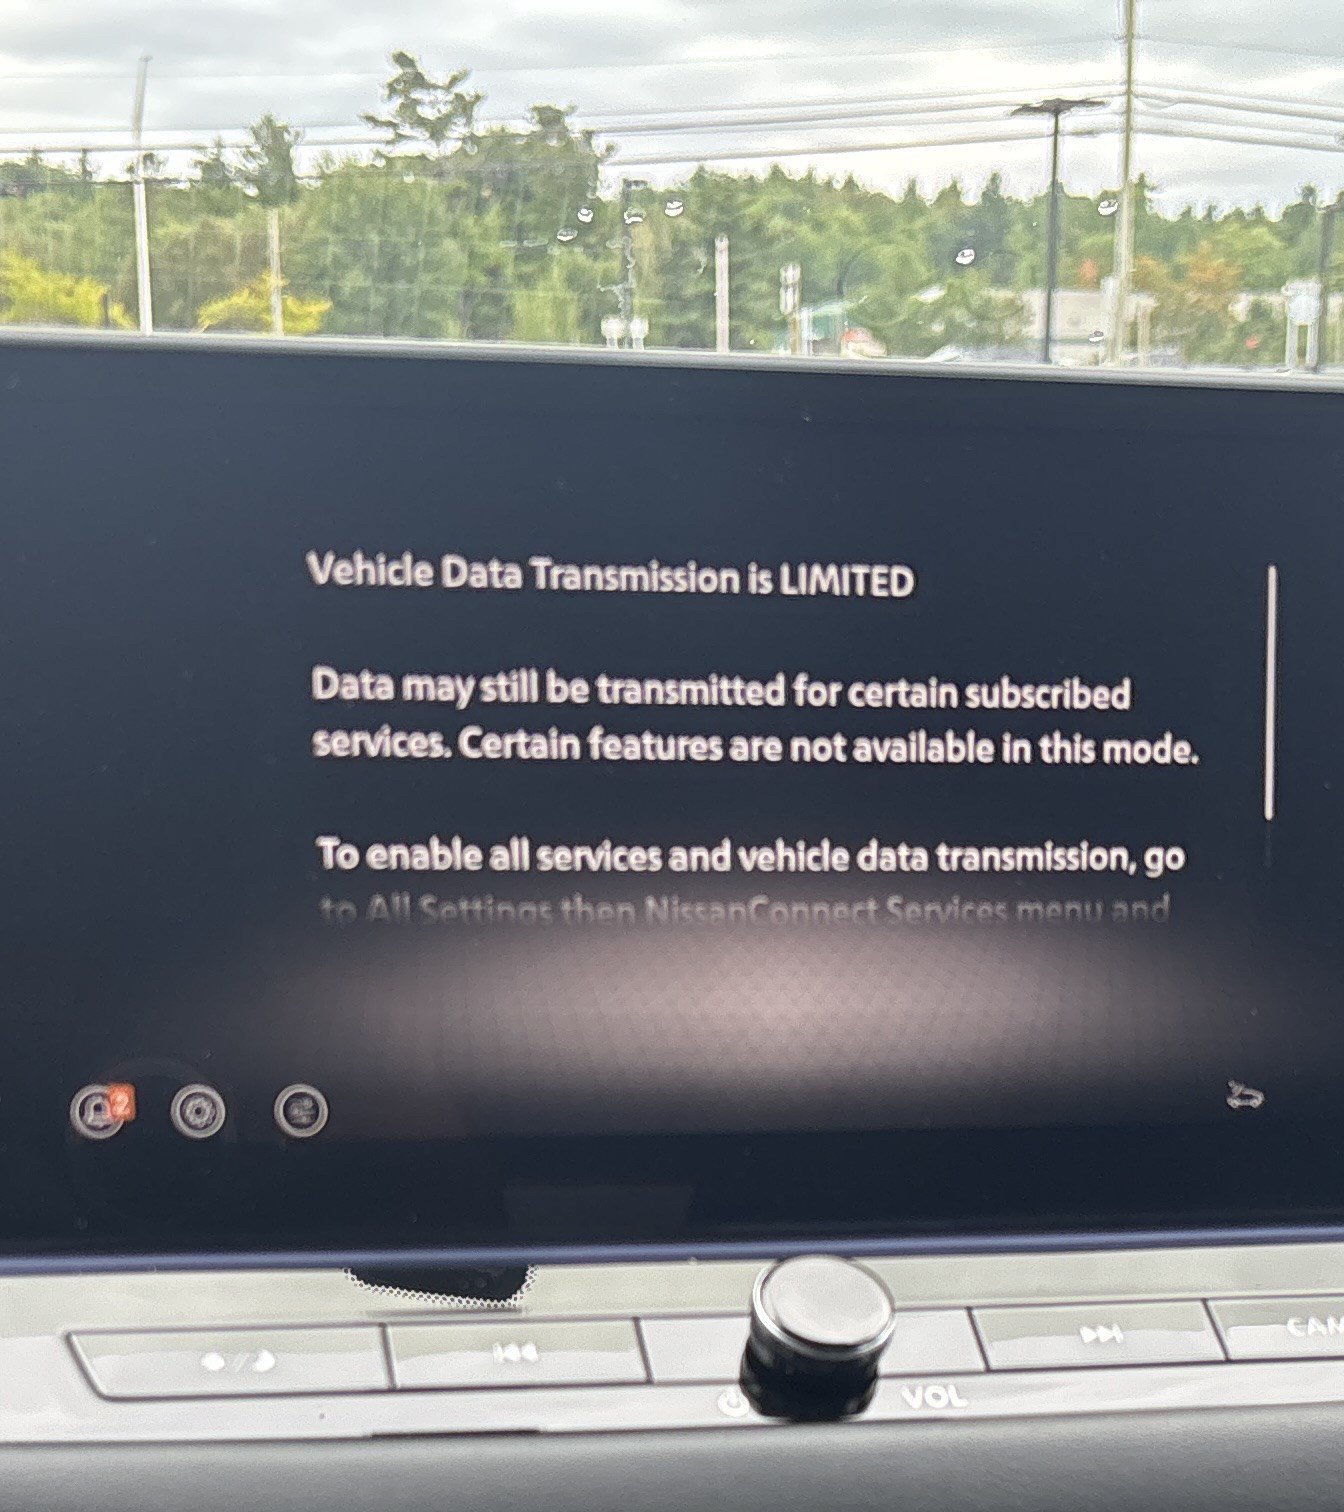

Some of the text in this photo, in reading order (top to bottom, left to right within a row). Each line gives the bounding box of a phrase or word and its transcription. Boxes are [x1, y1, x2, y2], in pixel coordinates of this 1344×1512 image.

[305, 550, 915, 598] Vehicle Data Transmission is LIMITED
[311, 665, 1132, 710] Data may still be transmitted for certain subscribed
[311, 725, 1200, 766] services. Certain features are not available in this mode.
[316, 834, 1186, 878] To enable all services and vehicle data transmission, go
[320, 891, 1171, 926] to All Settings then NissanConnect Services menu and
[900, 1383, 969, 1410] VOL
